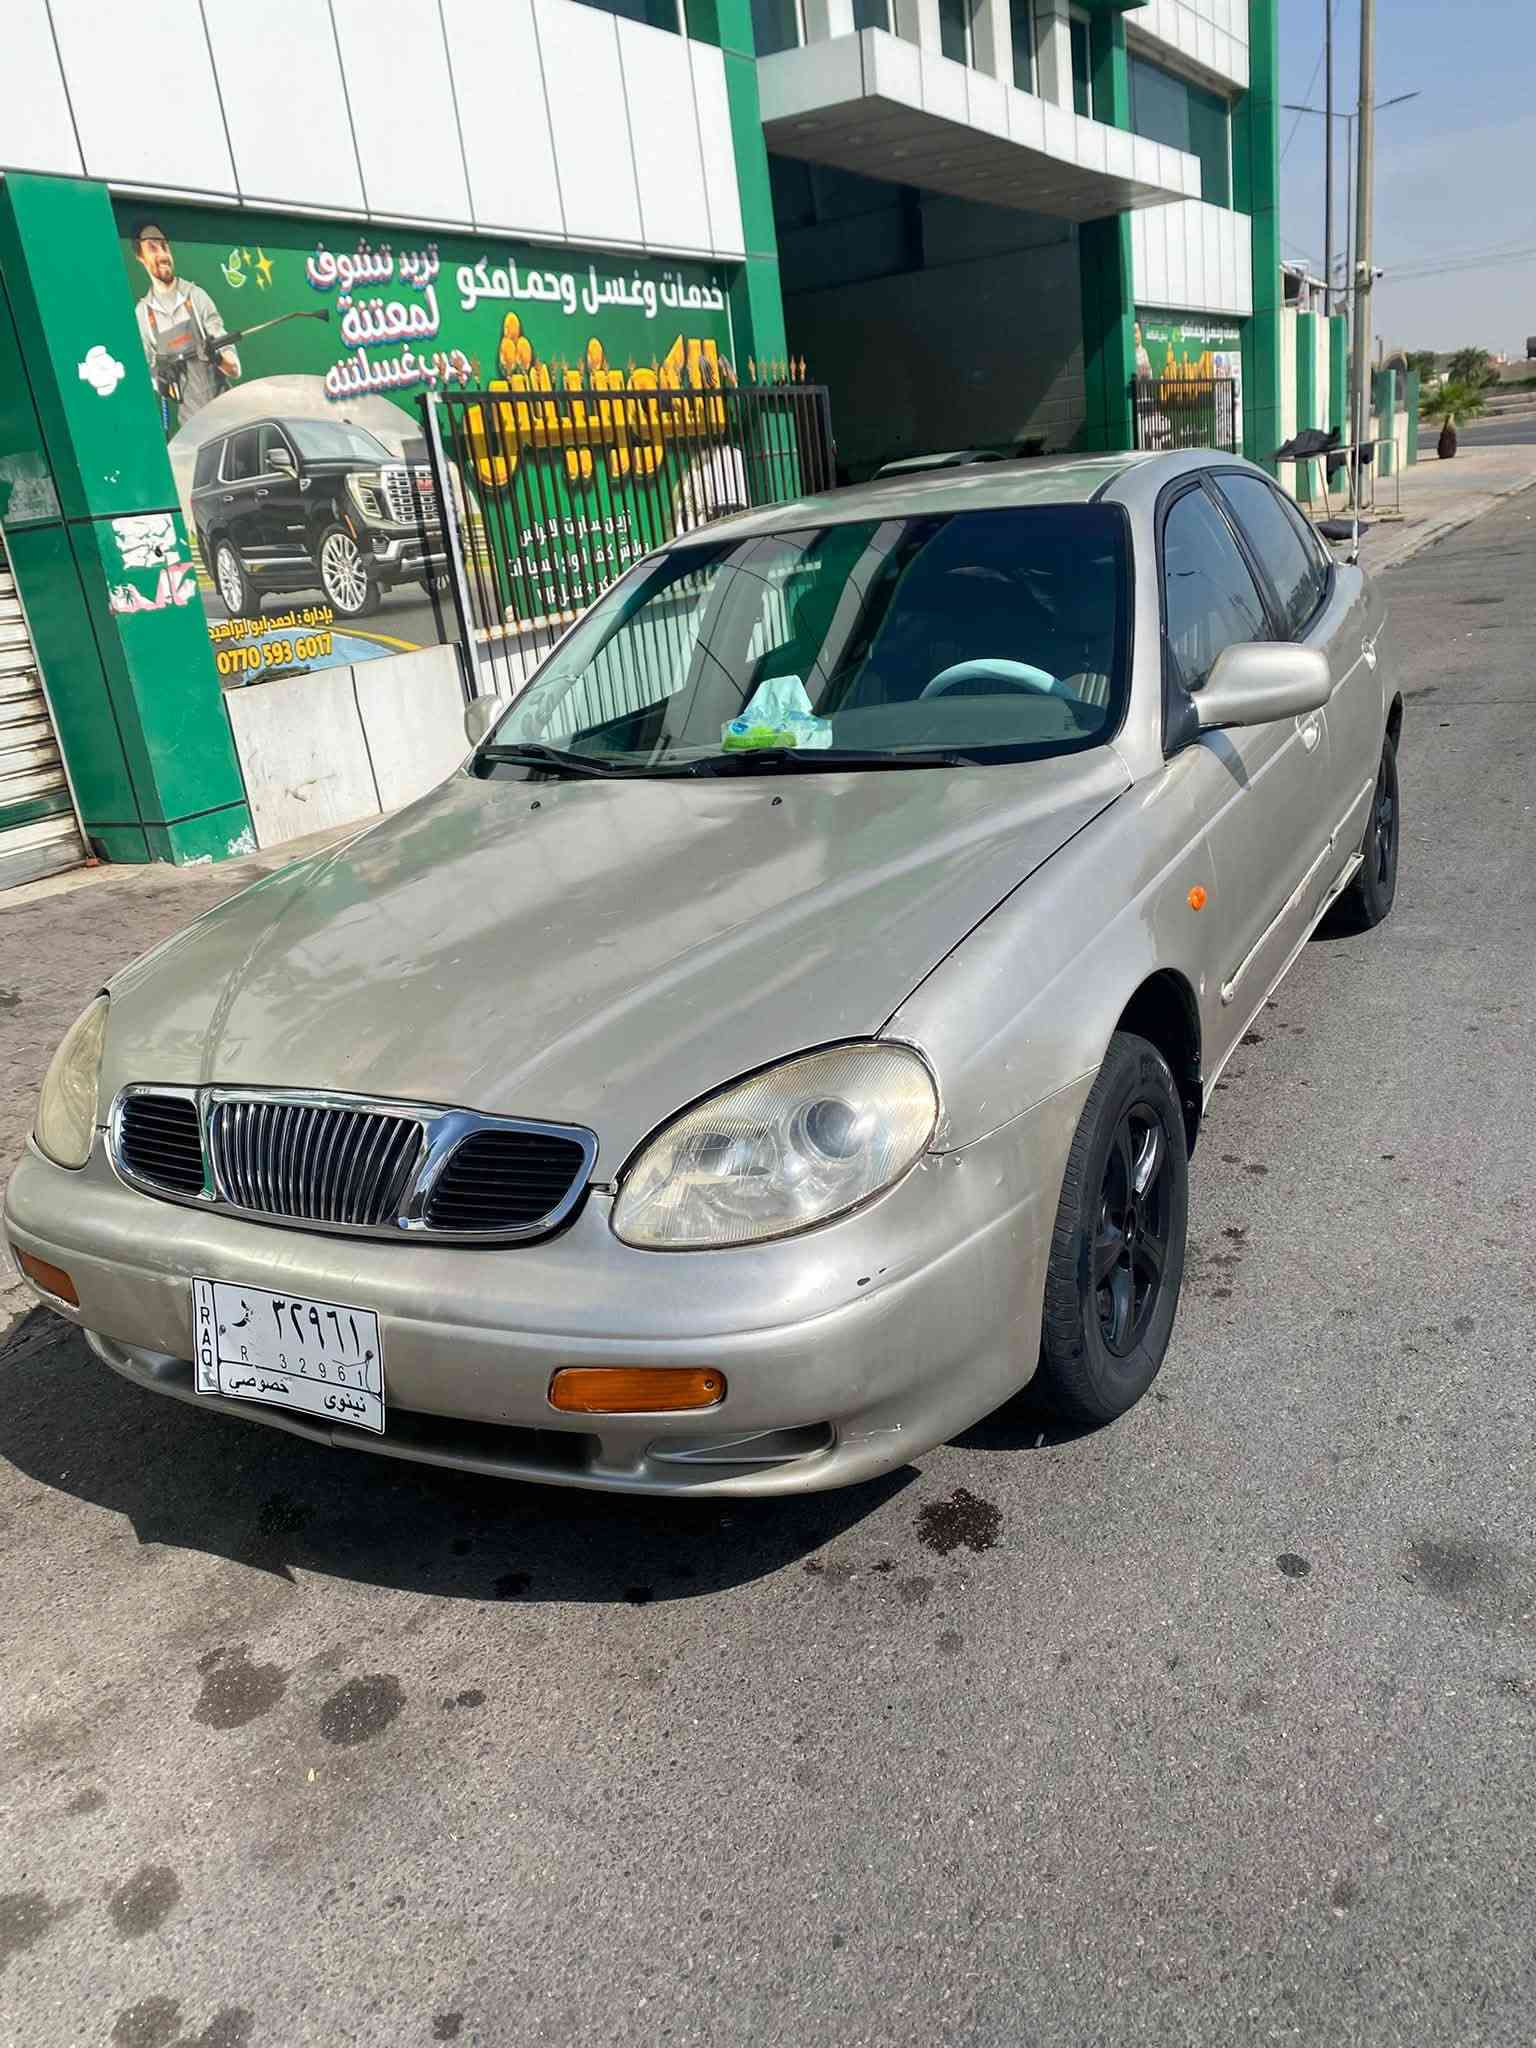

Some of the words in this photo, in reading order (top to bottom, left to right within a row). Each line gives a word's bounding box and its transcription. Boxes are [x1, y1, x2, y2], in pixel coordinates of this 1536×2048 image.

[306, 237, 394, 291] تشوف
[399, 243, 440, 288] تريد
[660, 272, 724, 311] خدمات
[216, 646, 260, 675] 0770
[262, 640, 293, 666] 593
[295, 632, 332, 660] 6017
[200, 1285, 212, 1367] IRAQ
[240, 1345, 249, 1361] R
[229, 1374, 290, 1394] خصوصي
[323, 1392, 367, 1418] نينوى
